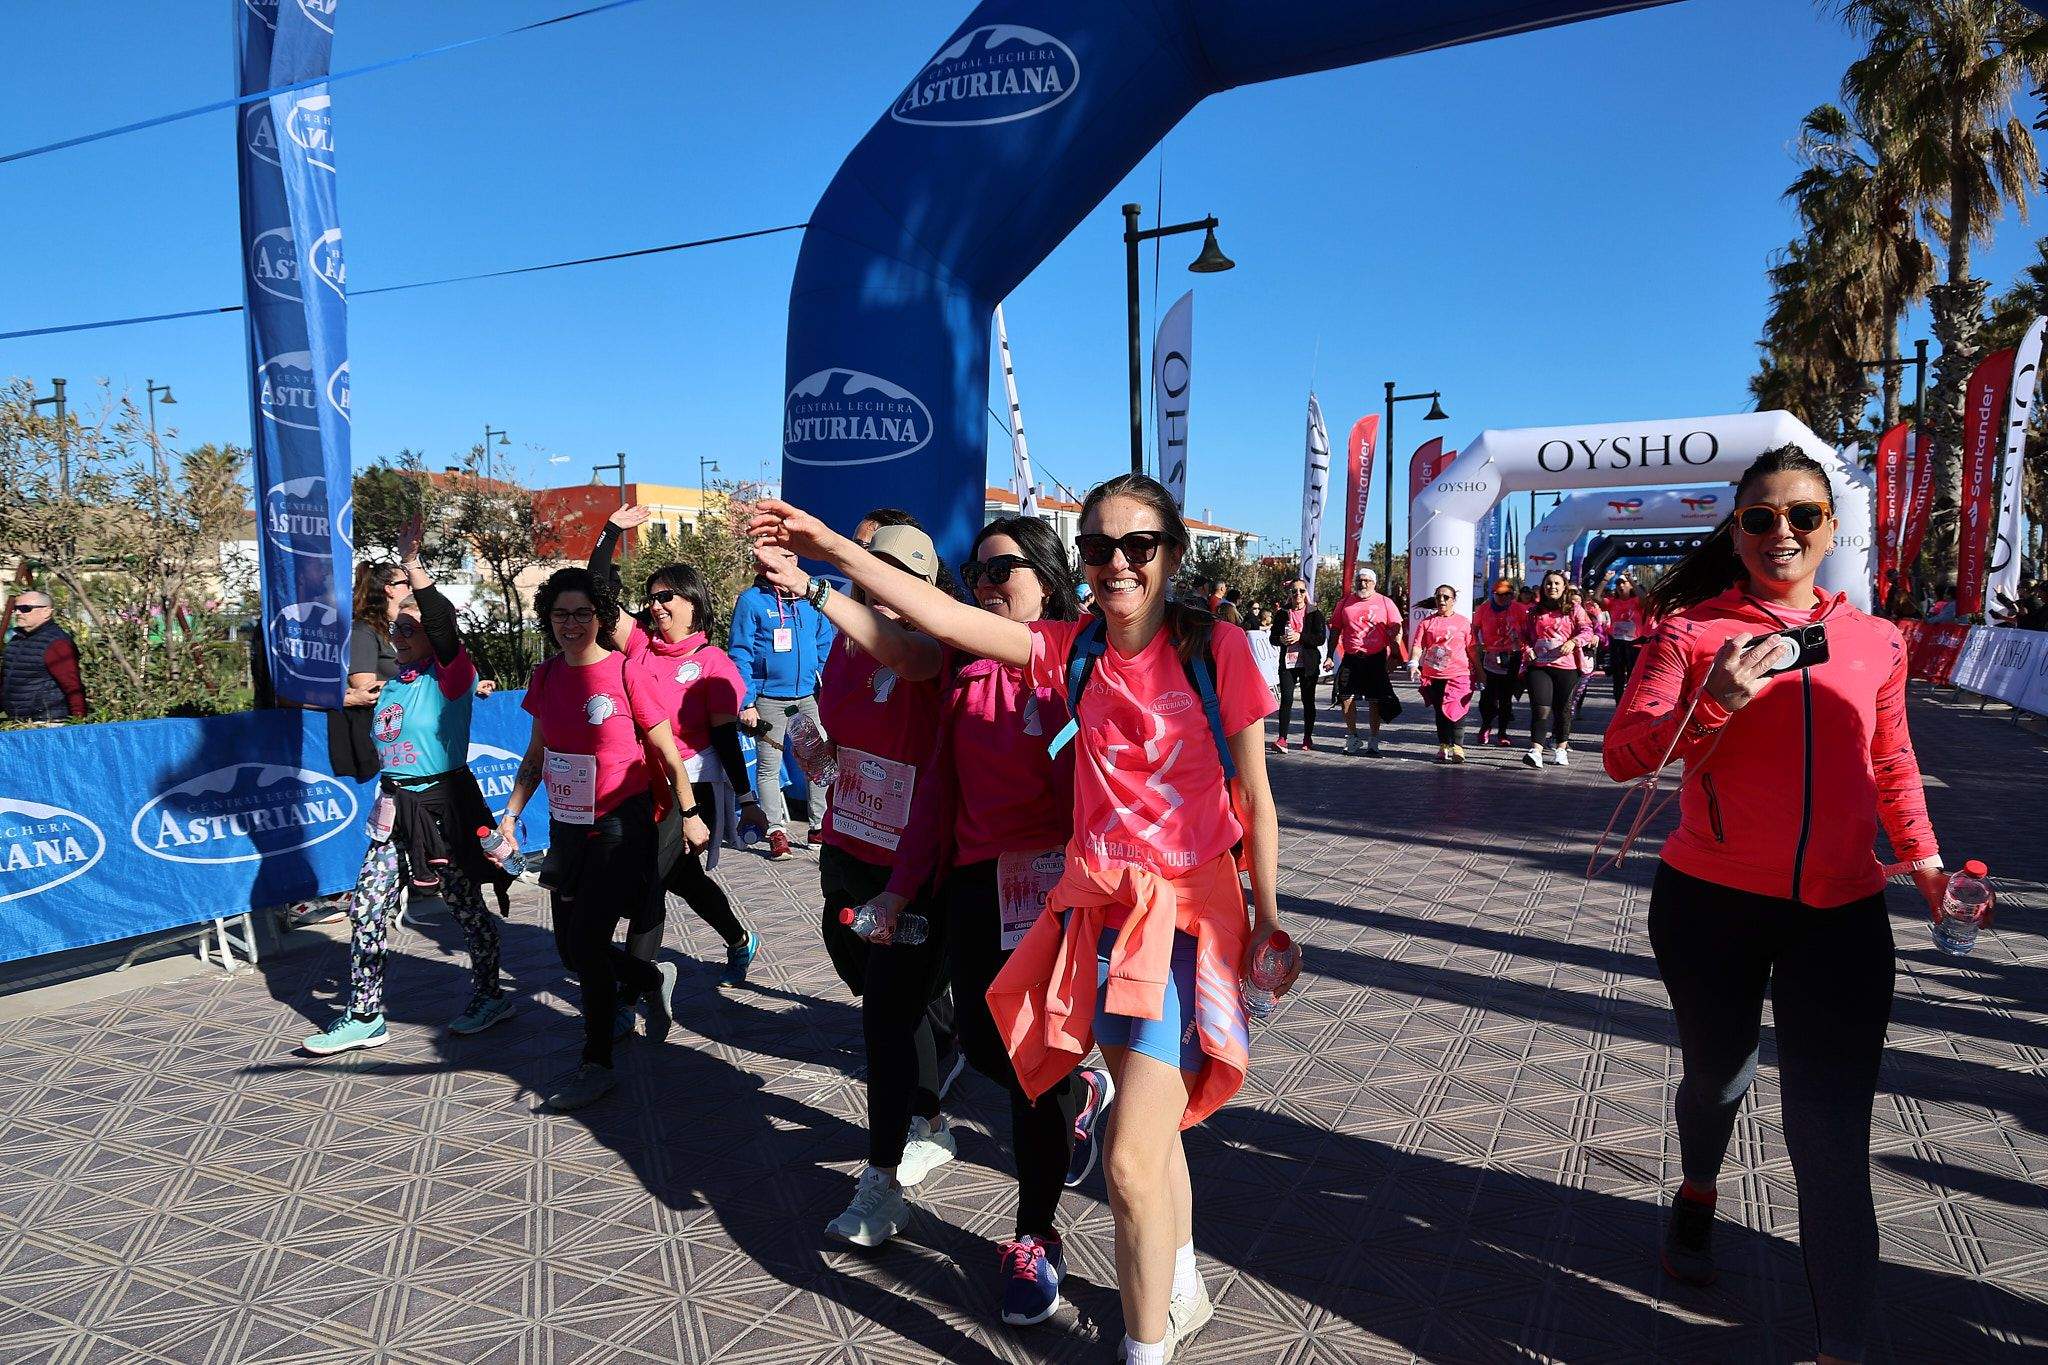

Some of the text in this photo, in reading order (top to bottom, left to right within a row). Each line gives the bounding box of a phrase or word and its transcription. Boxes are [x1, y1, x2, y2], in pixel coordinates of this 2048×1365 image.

[929, 49, 1056, 80] CENTRAL LECHERA
[899, 65, 1064, 114] ASTURIANA
[796, 401, 912, 414] CENTRAL LECHERA
[1162, 350, 1191, 485] SHO
[784, 410, 919, 445] ASTURIANA
[1971, 383, 1995, 497] Santander
[1537, 431, 1719, 473] OYSHO
[1356, 438, 1371, 524] Santander
[1420, 462, 1433, 487] der
[1438, 481, 1487, 493] OYSHO
[1886, 449, 1898, 527] Santander
[268, 502, 330, 537] ASTUR
[1416, 546, 1460, 557] OYSHO
[1625, 540, 1702, 549] VOLVO
[187, 786, 332, 815] CENTRAL LECHERA
[858, 790, 883, 811] 016
[155, 799, 347, 850] ASTURIANA
[0, 836, 90, 873] ANA
